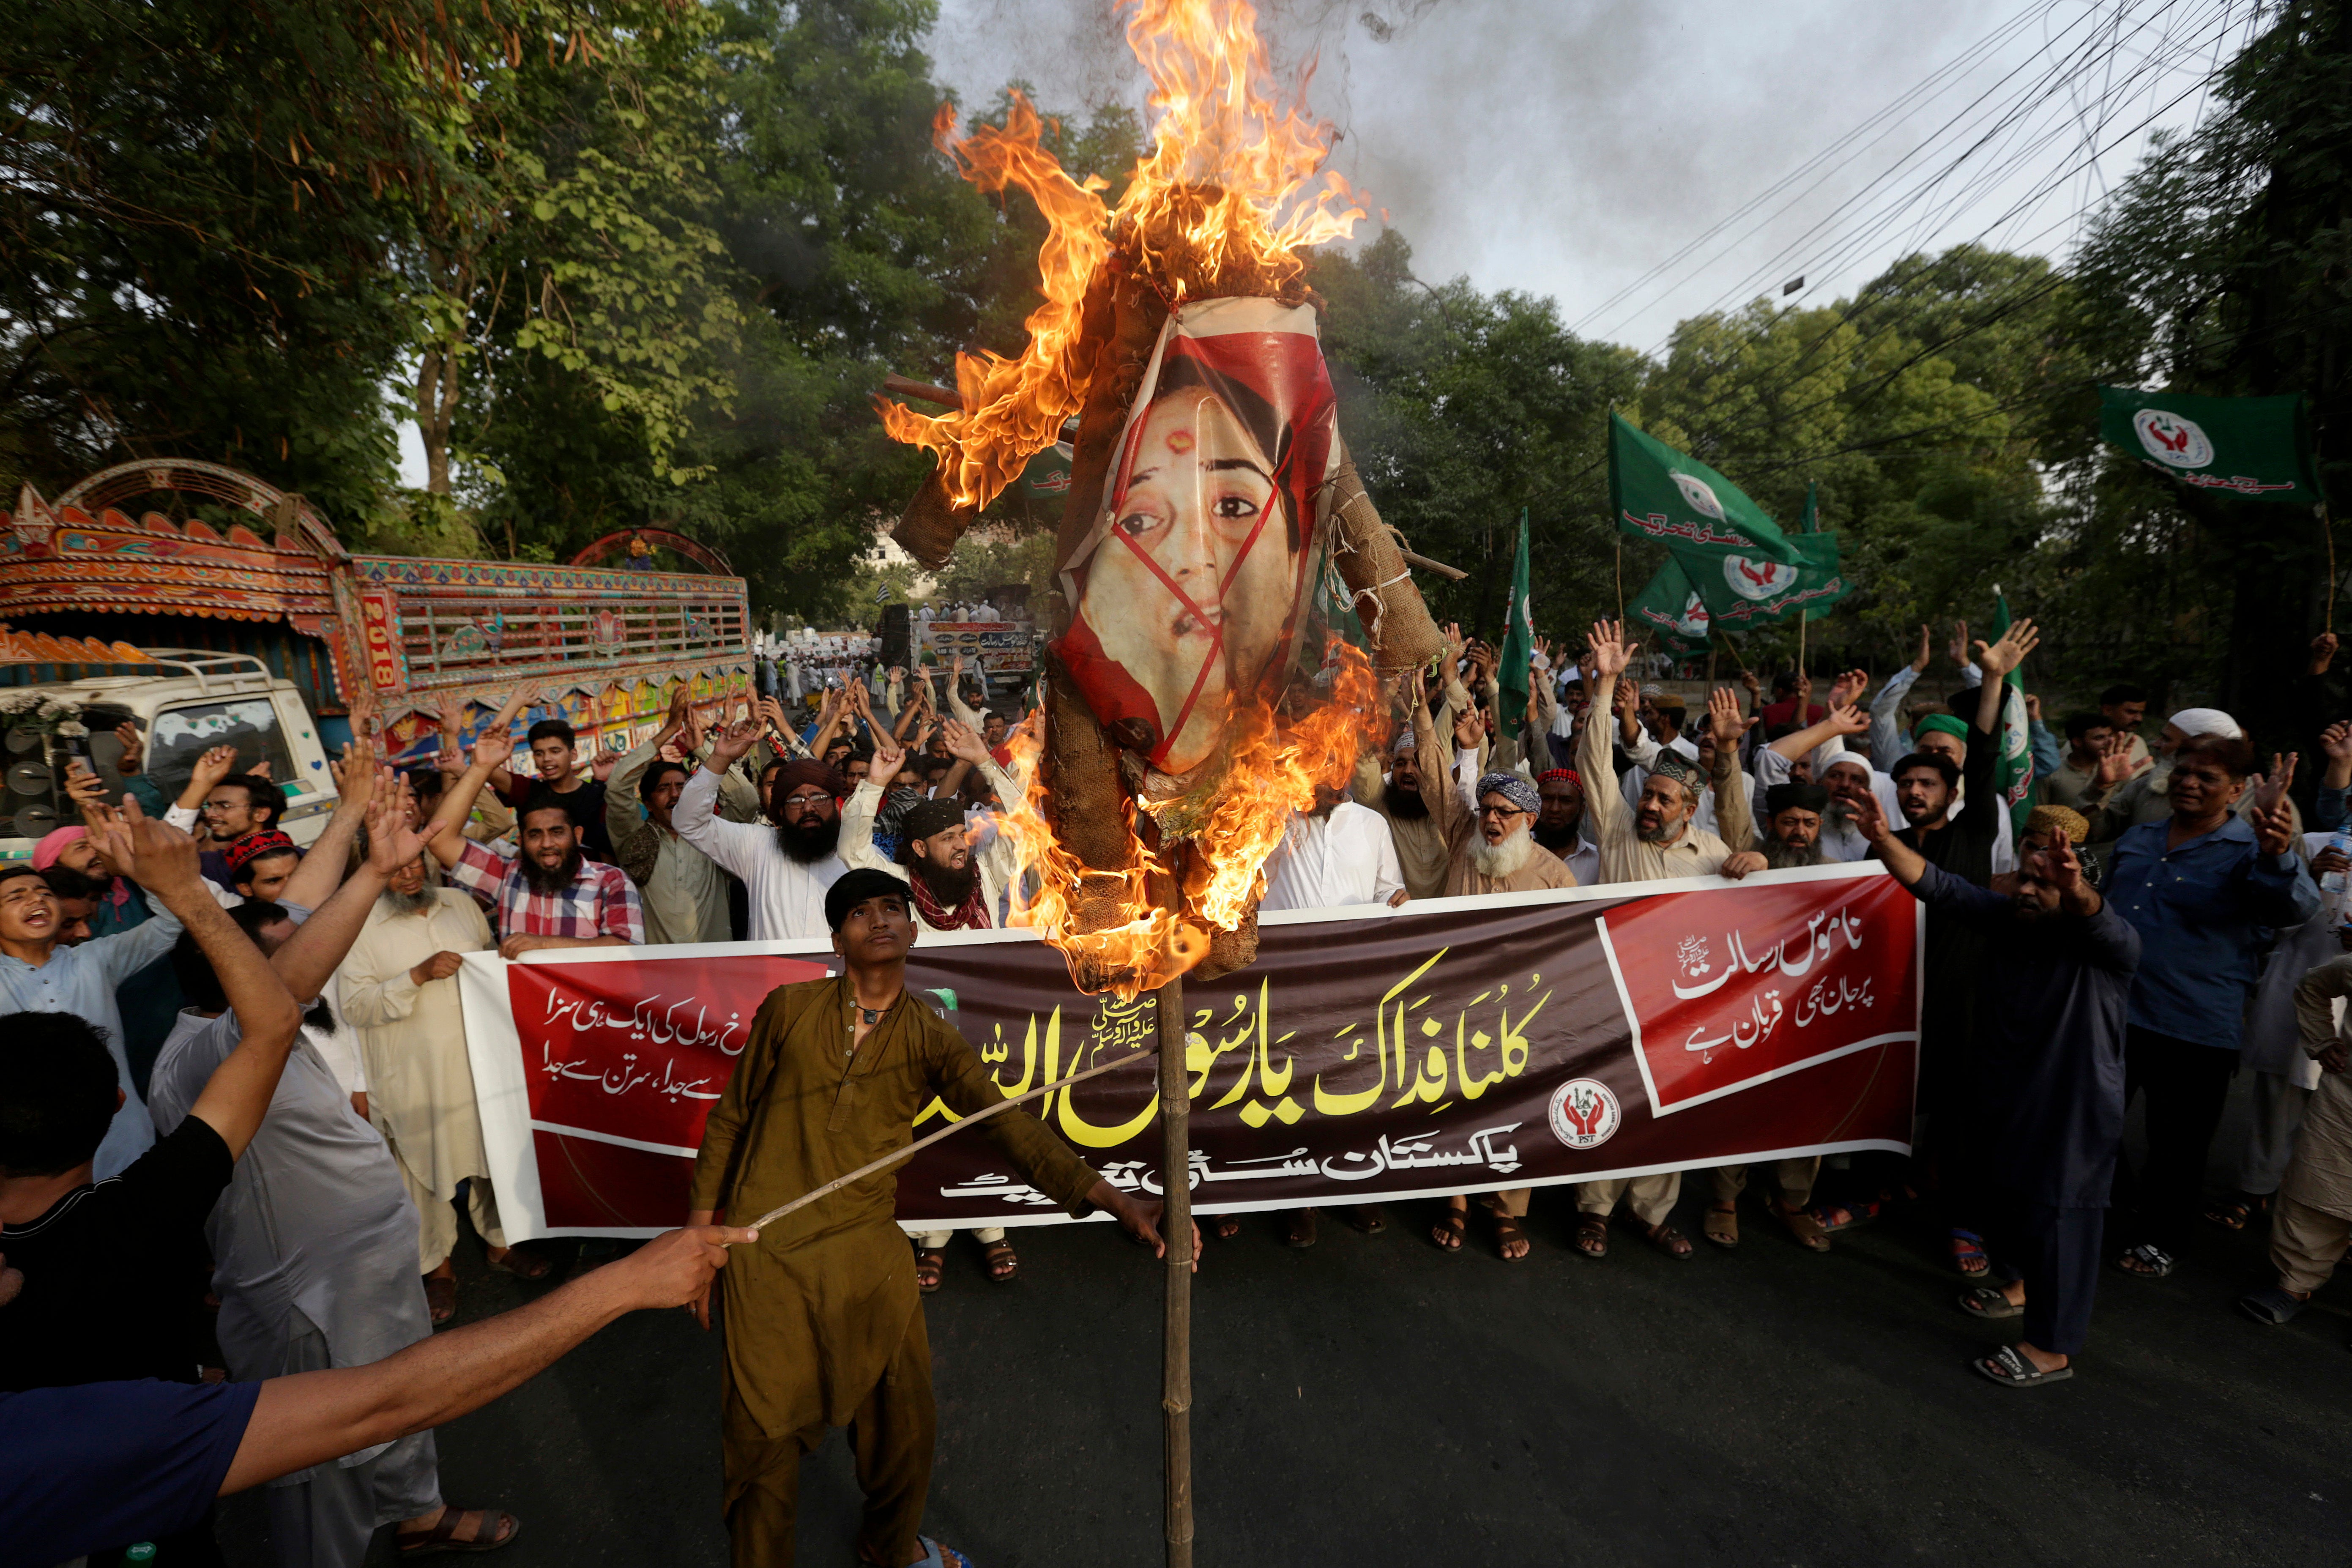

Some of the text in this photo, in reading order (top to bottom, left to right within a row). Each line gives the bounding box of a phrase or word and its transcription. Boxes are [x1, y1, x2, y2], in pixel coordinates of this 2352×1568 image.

[364, 601, 394, 685] 2018
[1672, 906, 1862, 1000] ناموس رسالت
[543, 987, 579, 1025] سزا
[572, 1000, 605, 1032] ہی
[605, 993, 662, 1040] ایک
[651, 996, 696, 1045] کی
[676, 1005, 719, 1046] رسول
[1685, 975, 1874, 1065] پر جان بھی قربان ہے
[542, 1039, 564, 1081] جدا
[561, 1059, 602, 1081] سے
[602, 1053, 637, 1095] تن
[618, 1071, 651, 1096] سر
[681, 1077, 722, 1100] سے
[1578, 1135, 1596, 1144] PST
